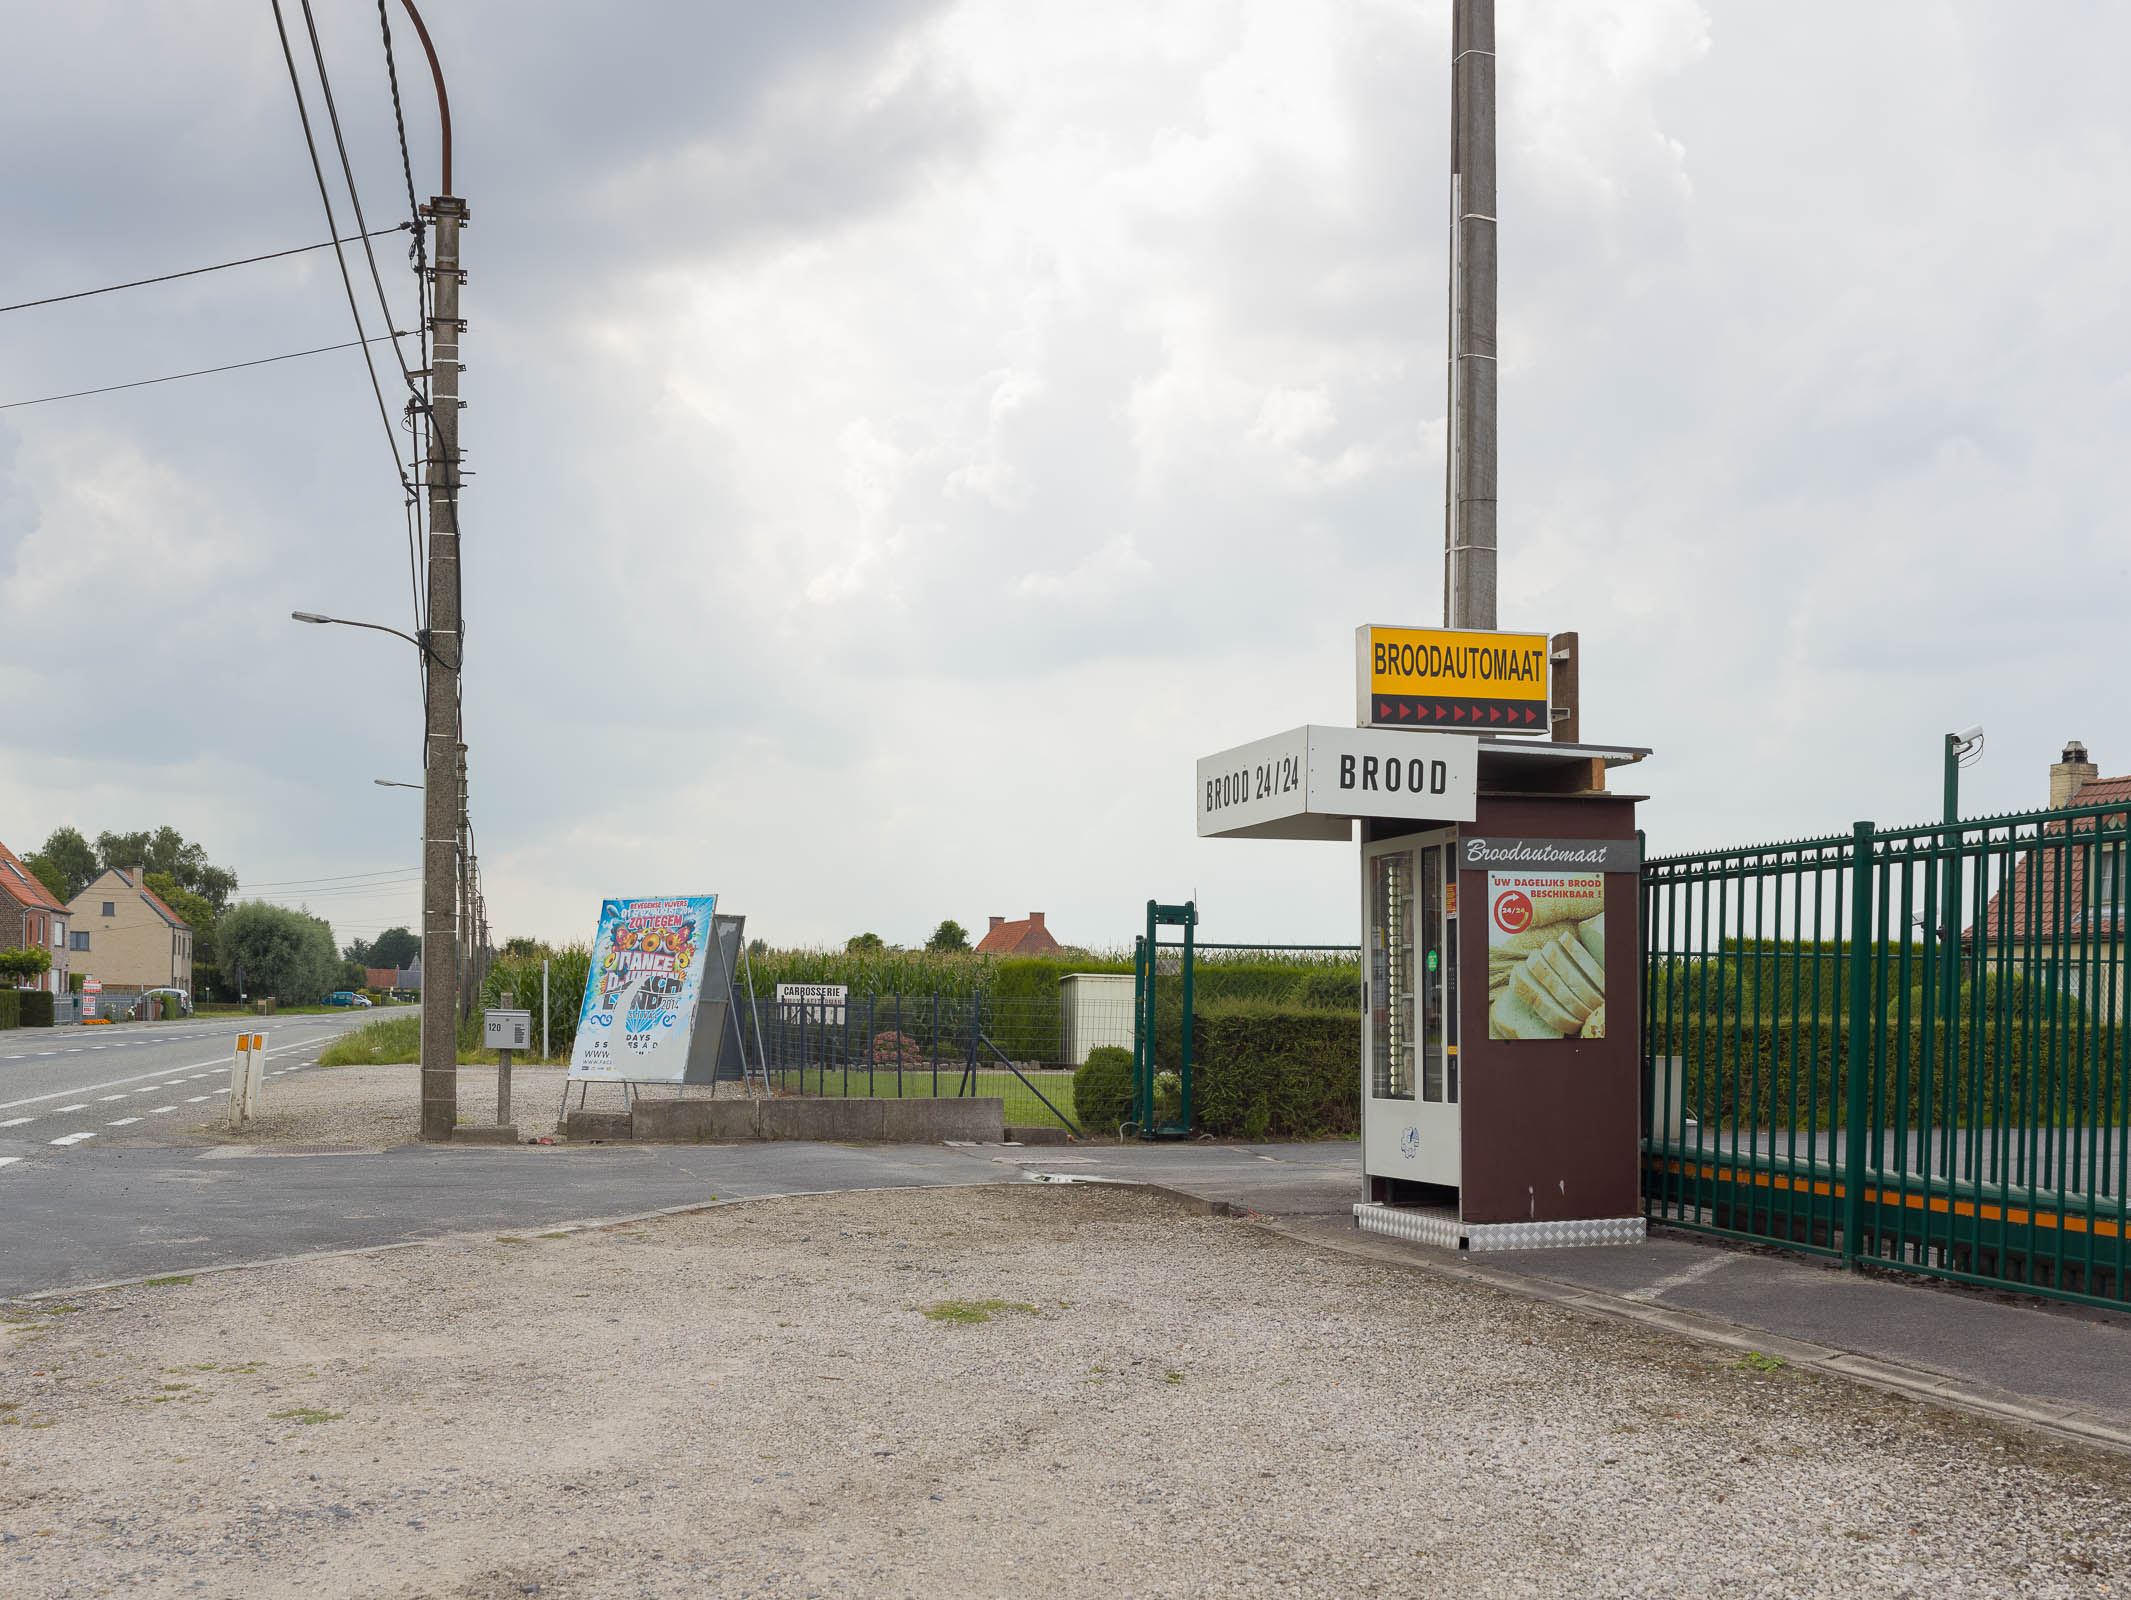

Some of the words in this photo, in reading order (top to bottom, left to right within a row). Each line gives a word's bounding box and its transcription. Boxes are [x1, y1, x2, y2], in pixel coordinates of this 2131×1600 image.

[1374, 642, 1543, 682] BROODAUTOMAAT
[1339, 753, 1447, 795] BROOD
[1206, 769, 1249, 812] BROOD
[1256, 755, 1299, 799] 24/24
[1466, 838, 1608, 863] Broodautomaat
[1494, 878, 1511, 887] UW
[1514, 879, 1565, 887] DAGELIJKS
[1568, 879, 1602, 888] BROOD
[1530, 889, 1594, 898] BESCHIKBAAR
[1501, 907, 1526, 915] 24/24
[629, 914, 682, 929] ZOTTEGEM
[488, 1023, 501, 1032] 120
[626, 1034, 651, 1042] DAYS
